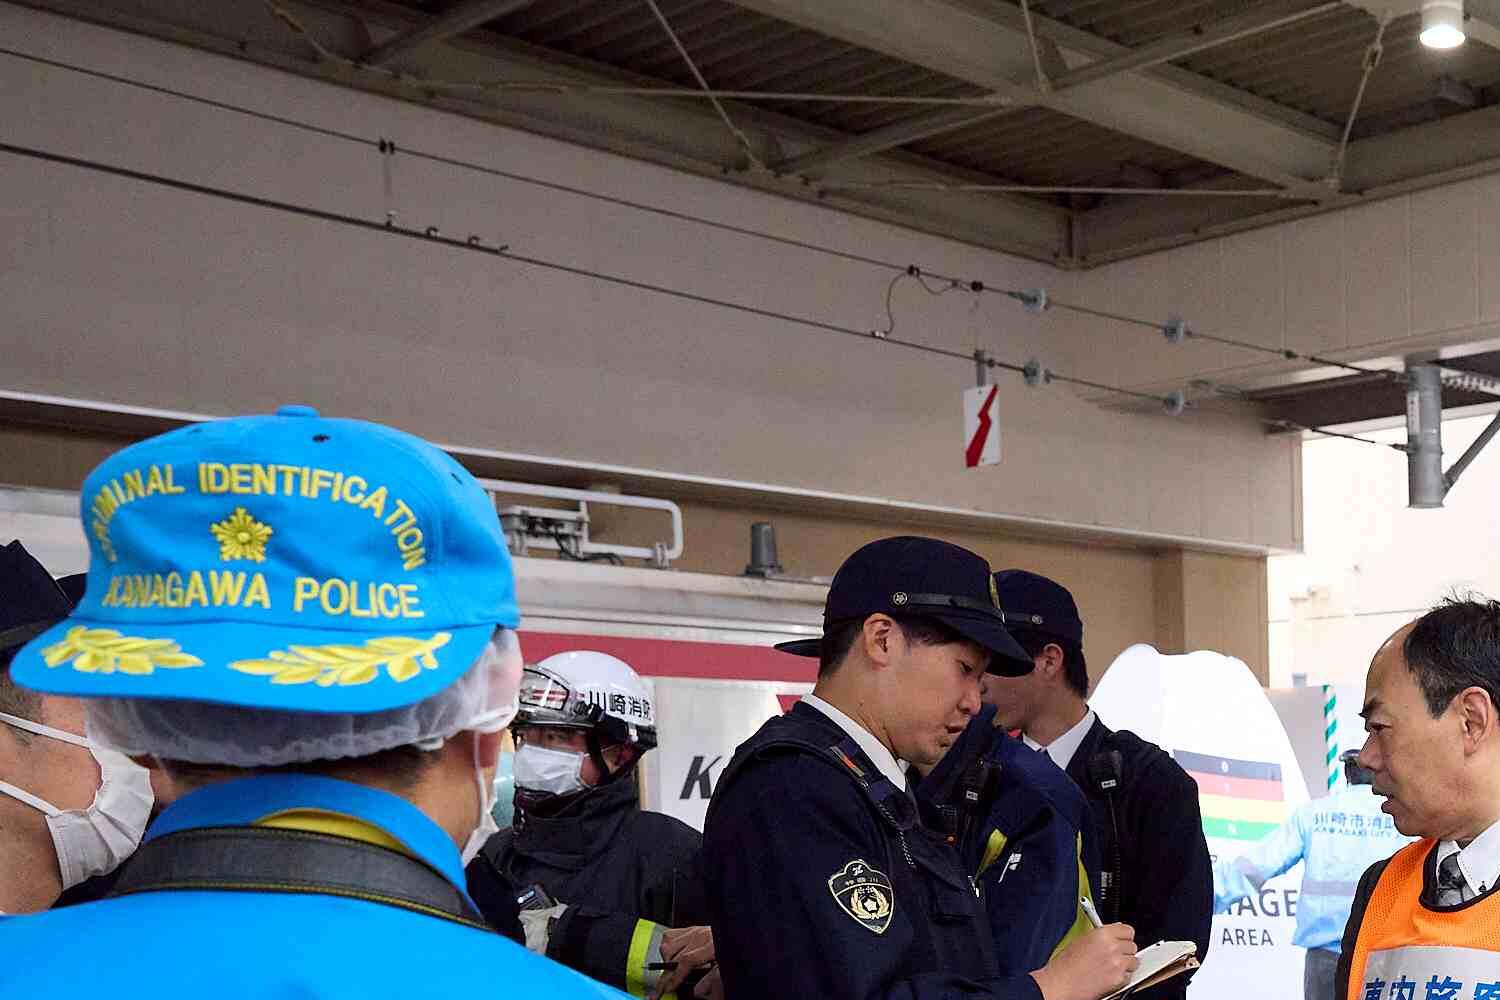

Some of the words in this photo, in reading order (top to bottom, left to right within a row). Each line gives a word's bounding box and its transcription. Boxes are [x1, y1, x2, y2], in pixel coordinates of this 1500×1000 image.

[198, 463, 427, 571] IDENTIFICATION
[102, 570, 272, 609] KANAGAWA
[293, 576, 425, 619] POLICE
[1228, 888, 1297, 918] AGE
[1221, 927, 1274, 946] AREA
